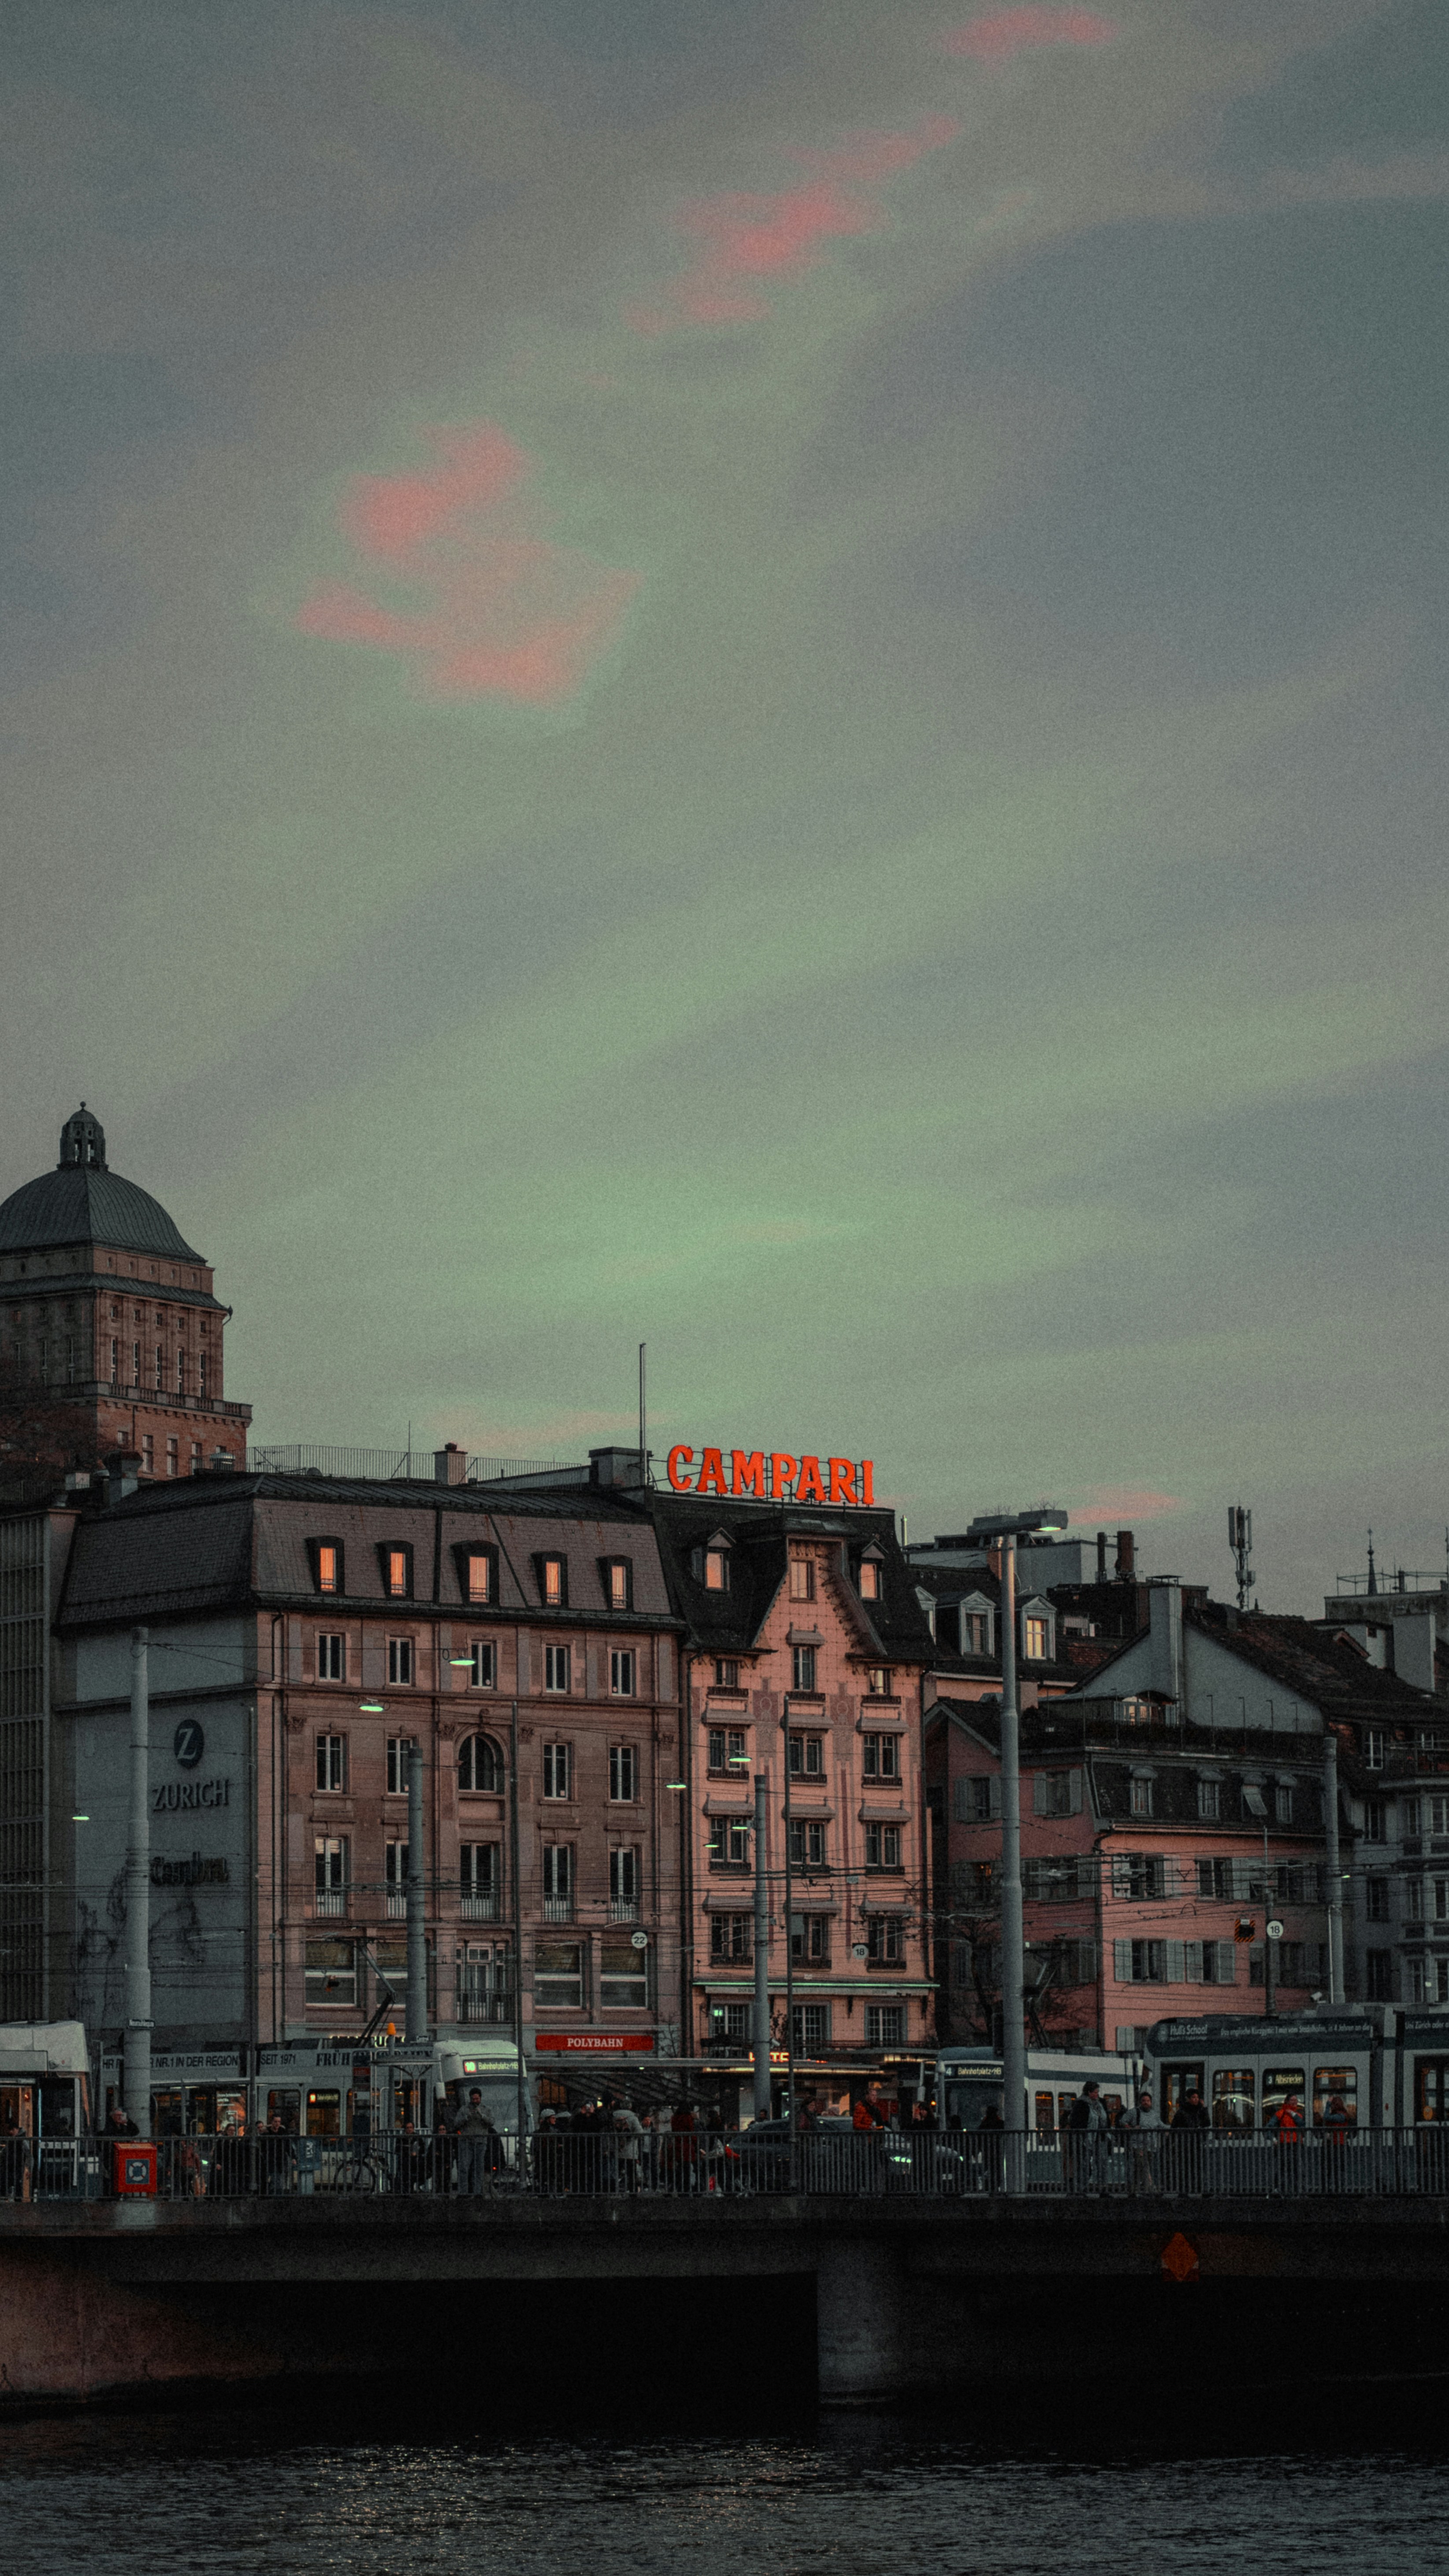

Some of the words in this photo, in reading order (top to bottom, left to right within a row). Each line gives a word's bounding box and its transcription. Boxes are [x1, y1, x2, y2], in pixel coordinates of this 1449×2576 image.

[668, 1445, 874, 1505] CAMPARI
[177, 1727, 196, 1760] Z
[152, 1779, 229, 1812] ZURICH
[1270, 1925, 1280, 1934] 18
[1187, 2024, 1208, 2035] School
[1415, 2020, 1431, 2030] Zürich
[567, 2038, 623, 2047] POLYBAHN
[187, 2056, 203, 2067] DER
[206, 2054, 238, 2066] REGION
[260, 2054, 277, 2065] SEIT
[280, 2053, 296, 2065] 1971
[316, 2050, 351, 2066] FRÜH
[465, 2061, 475, 2072] 10
